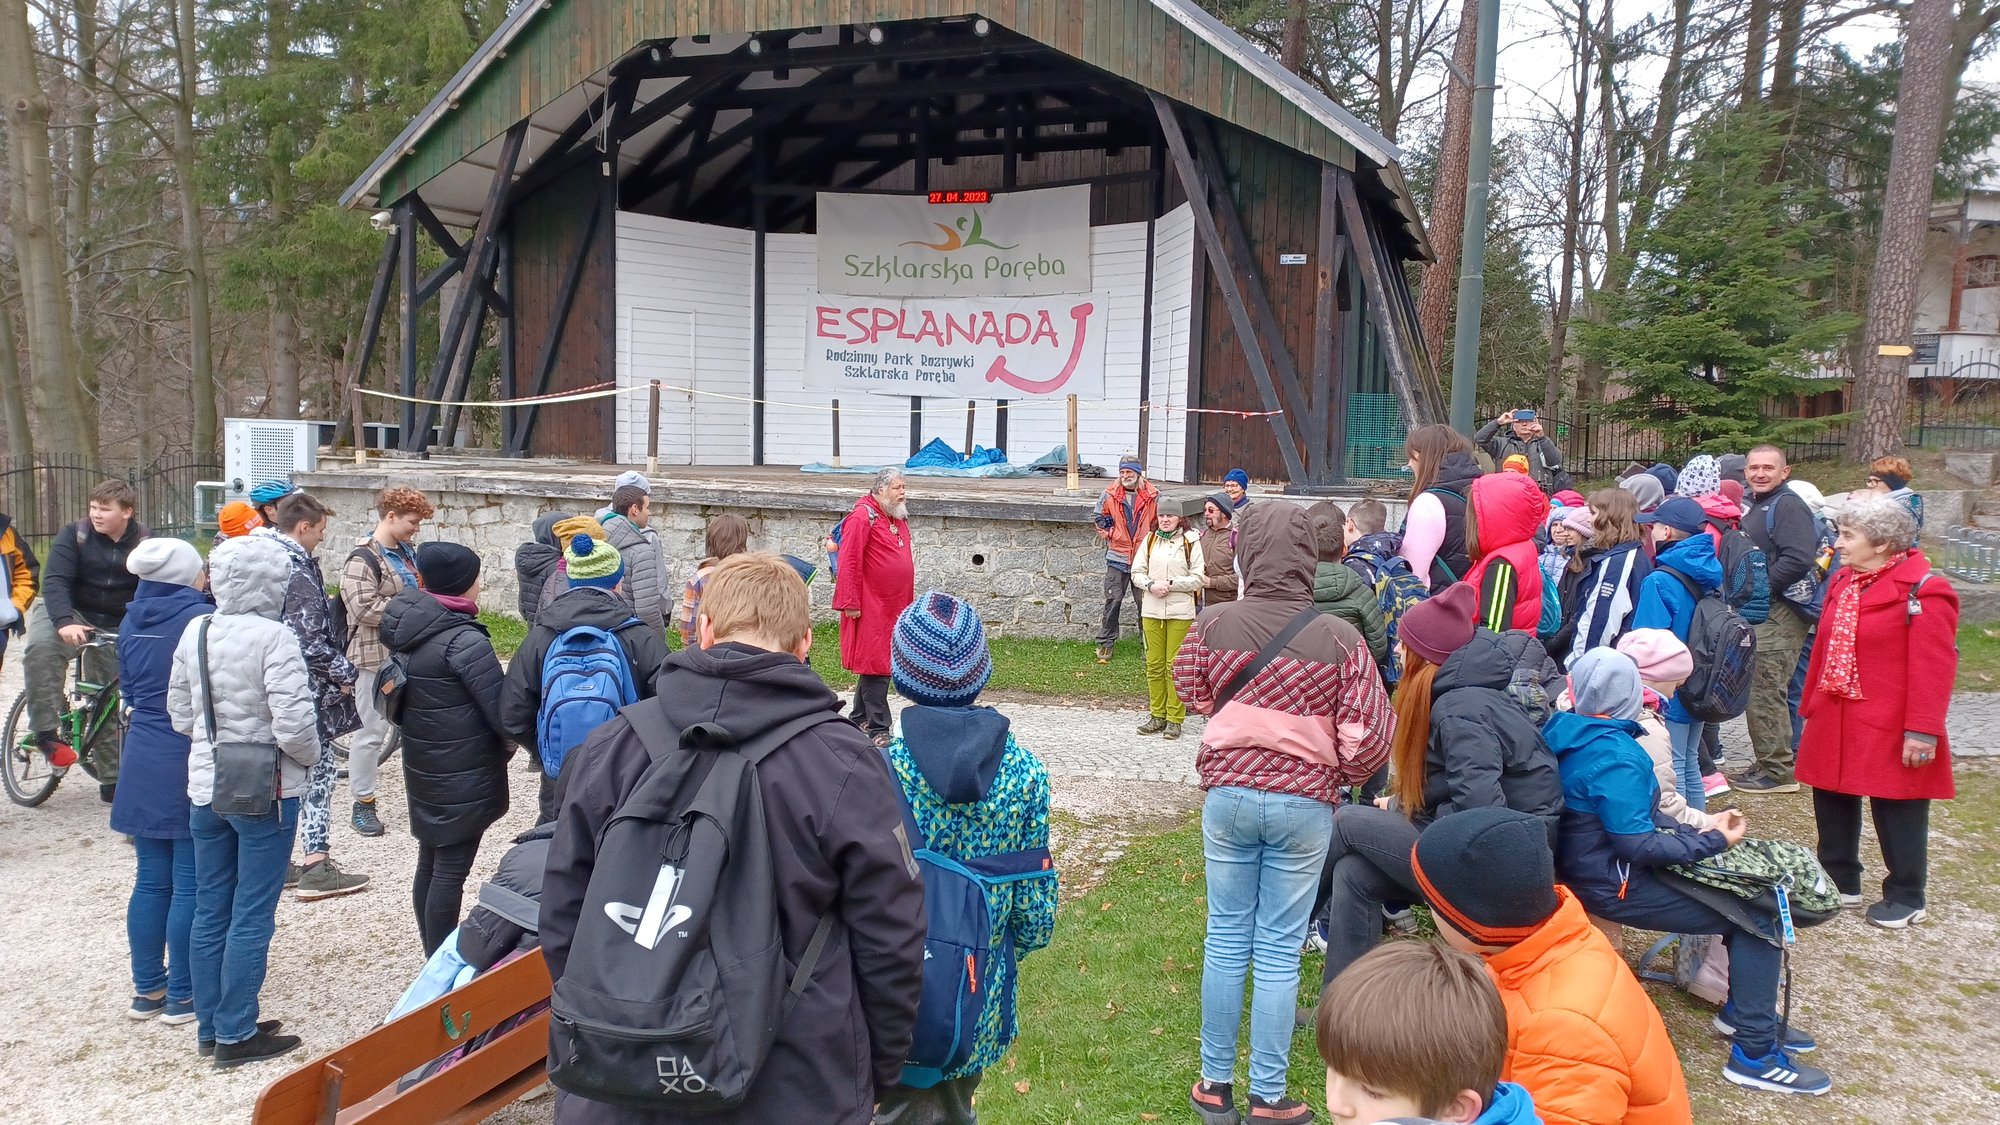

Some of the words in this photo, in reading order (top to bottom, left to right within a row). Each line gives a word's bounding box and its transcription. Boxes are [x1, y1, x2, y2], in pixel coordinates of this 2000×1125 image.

[929, 192, 988, 203] 27.04.2023
[844, 253, 973, 285] Szklarska
[984, 252, 1066, 281] Poręba
[815, 305, 1059, 348] ESPLANADA
[826, 349, 878, 366] Rodzinny
[884, 352, 913, 366] Park
[921, 354, 974, 369] Rozrywki
[844, 366, 909, 382] Szklarska
[915, 370, 956, 384] Poręba
